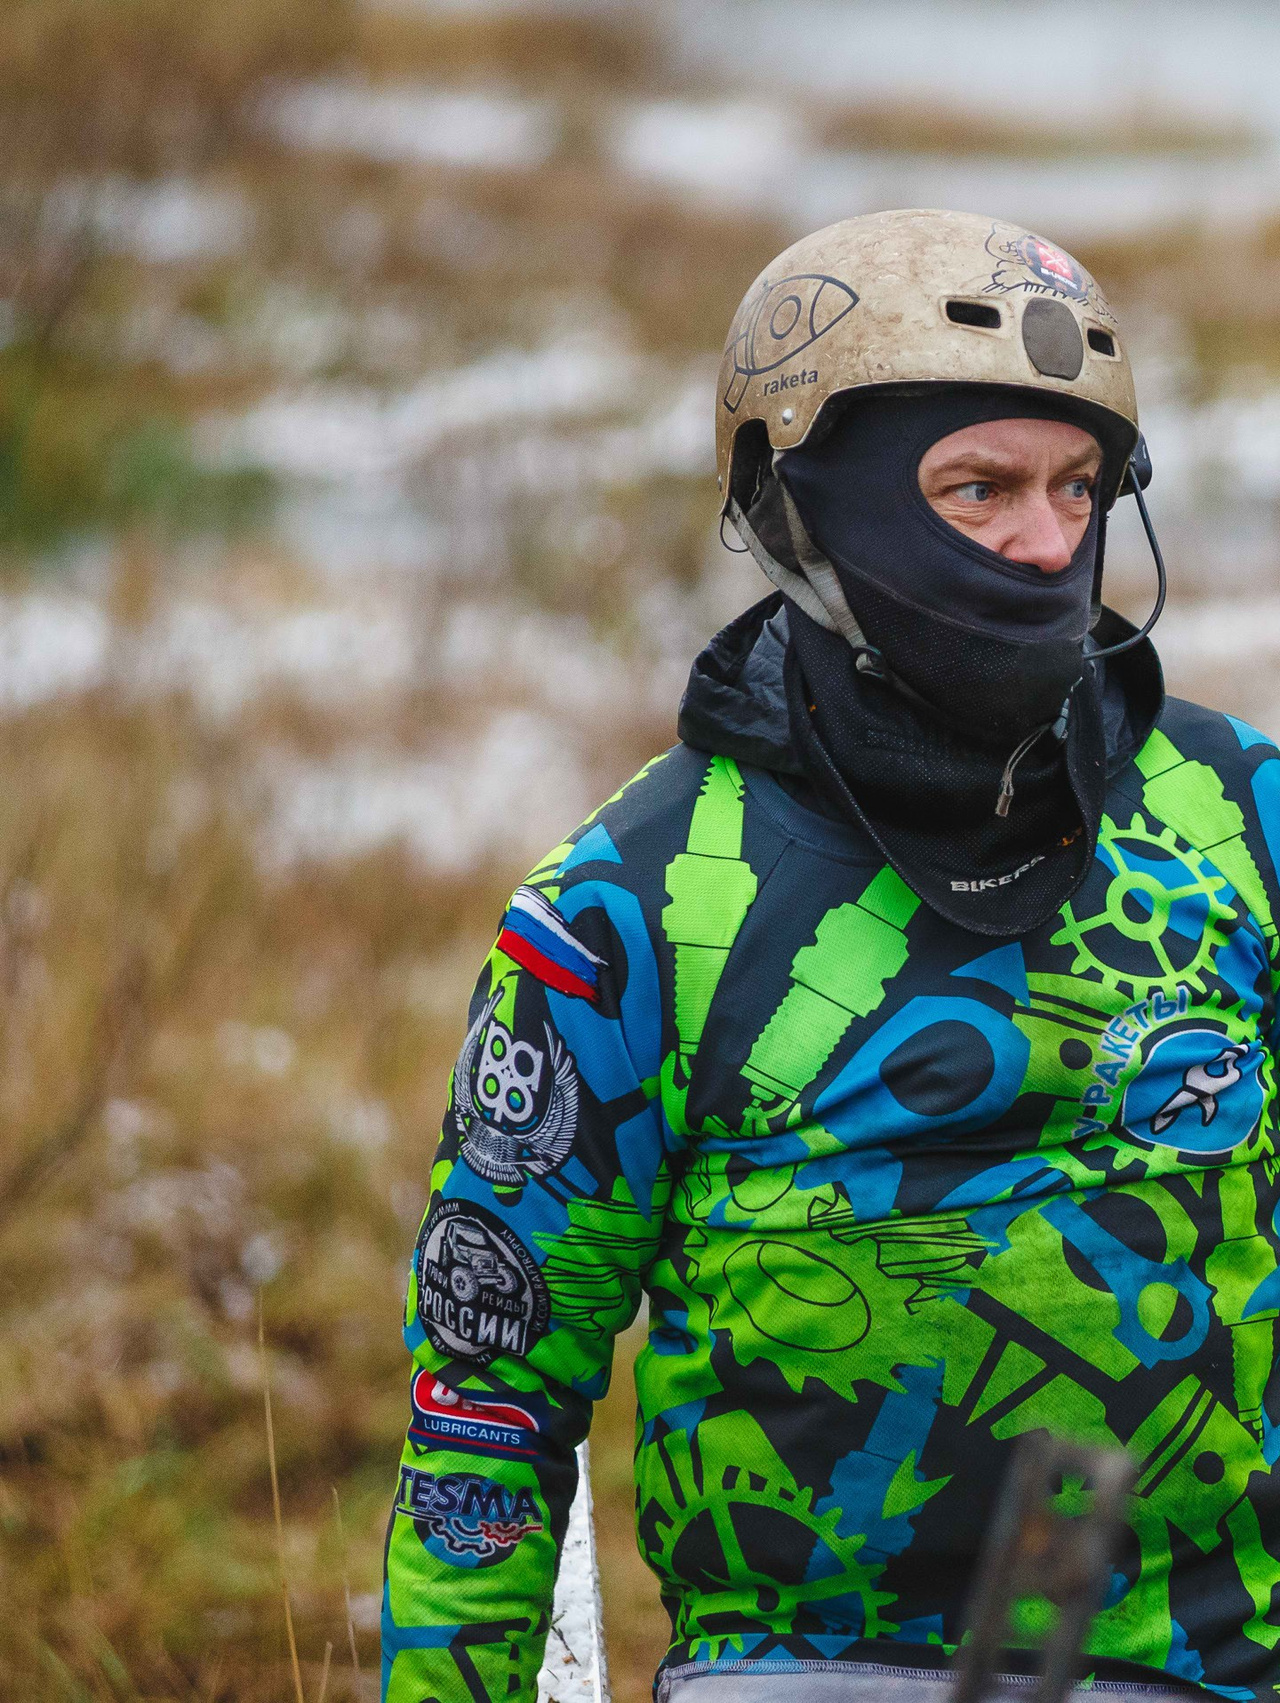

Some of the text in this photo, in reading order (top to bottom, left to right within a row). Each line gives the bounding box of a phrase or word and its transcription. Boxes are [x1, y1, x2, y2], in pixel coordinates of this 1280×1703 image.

[763, 369, 818, 396] raketa
[1072, 984, 1190, 1139] У РАКЕТЫ
[423, 1285, 521, 1351] РОССИИ
[424, 1418, 521, 1445] LUBRICANTS
[398, 1464, 543, 1523] TESMA
